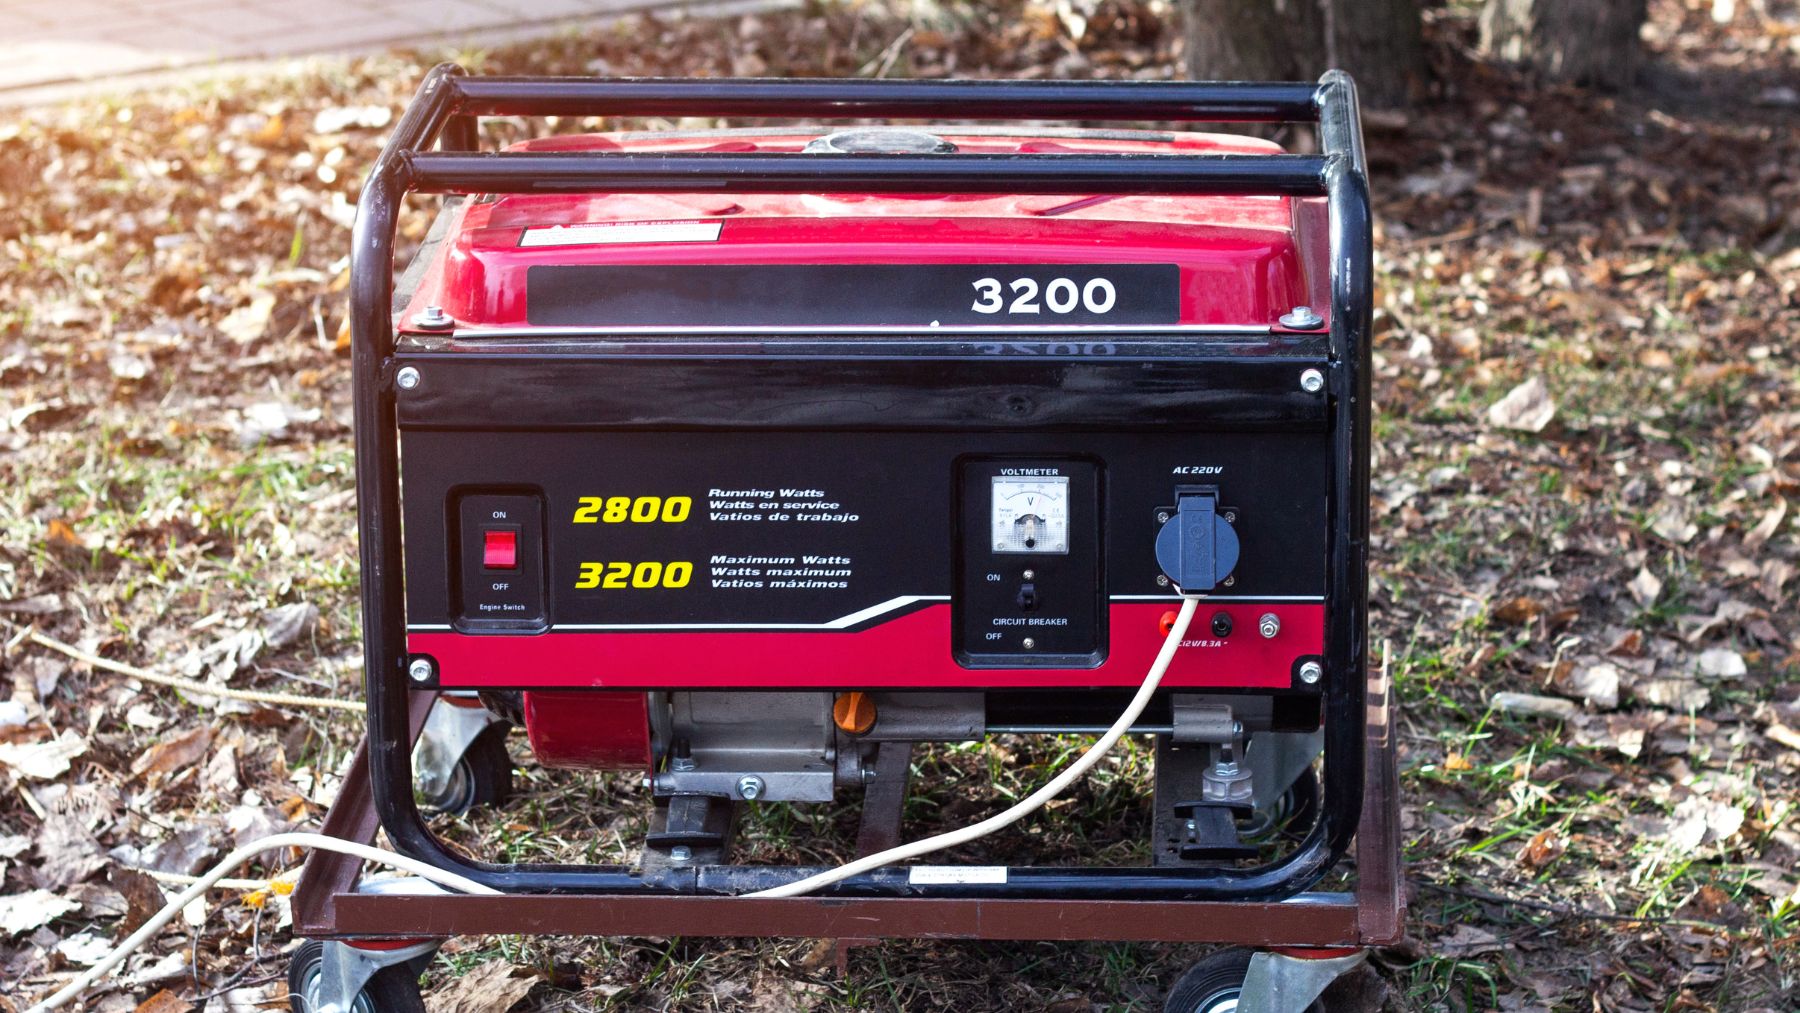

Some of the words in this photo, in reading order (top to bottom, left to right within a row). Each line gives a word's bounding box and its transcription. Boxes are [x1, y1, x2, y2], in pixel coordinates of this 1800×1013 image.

[972, 278, 1117, 314] 3200
[1173, 466, 1188, 474] AC
[1191, 466, 1223, 474] 220V
[708, 489, 774, 499] Running
[779, 489, 825, 498] Watts
[709, 501, 754, 510] Watts
[758, 502, 778, 510] en
[782, 501, 839, 510] service
[1027, 497, 1034, 506] V
[573, 496, 692, 523] 2800
[492, 511, 506, 519] ON
[710, 512, 762, 521] Vatios
[768, 512, 789, 521] de
[796, 512, 860, 523] trabajo
[710, 555, 796, 565] Maximum
[802, 555, 851, 565] Watts
[574, 562, 694, 589] 3200
[711, 568, 760, 576] Watts
[765, 568, 852, 577] maximum
[986, 573, 1001, 582] ON
[492, 582, 509, 591] OFF
[711, 579, 764, 588] Vatios
[769, 579, 848, 589] máximos
[479, 603, 501, 612] Engine
[503, 603, 526, 612] Switch
[993, 617, 1026, 626] CIRCUIT
[1028, 617, 1068, 626] BREAKER
[986, 632, 1002, 640] OFF
